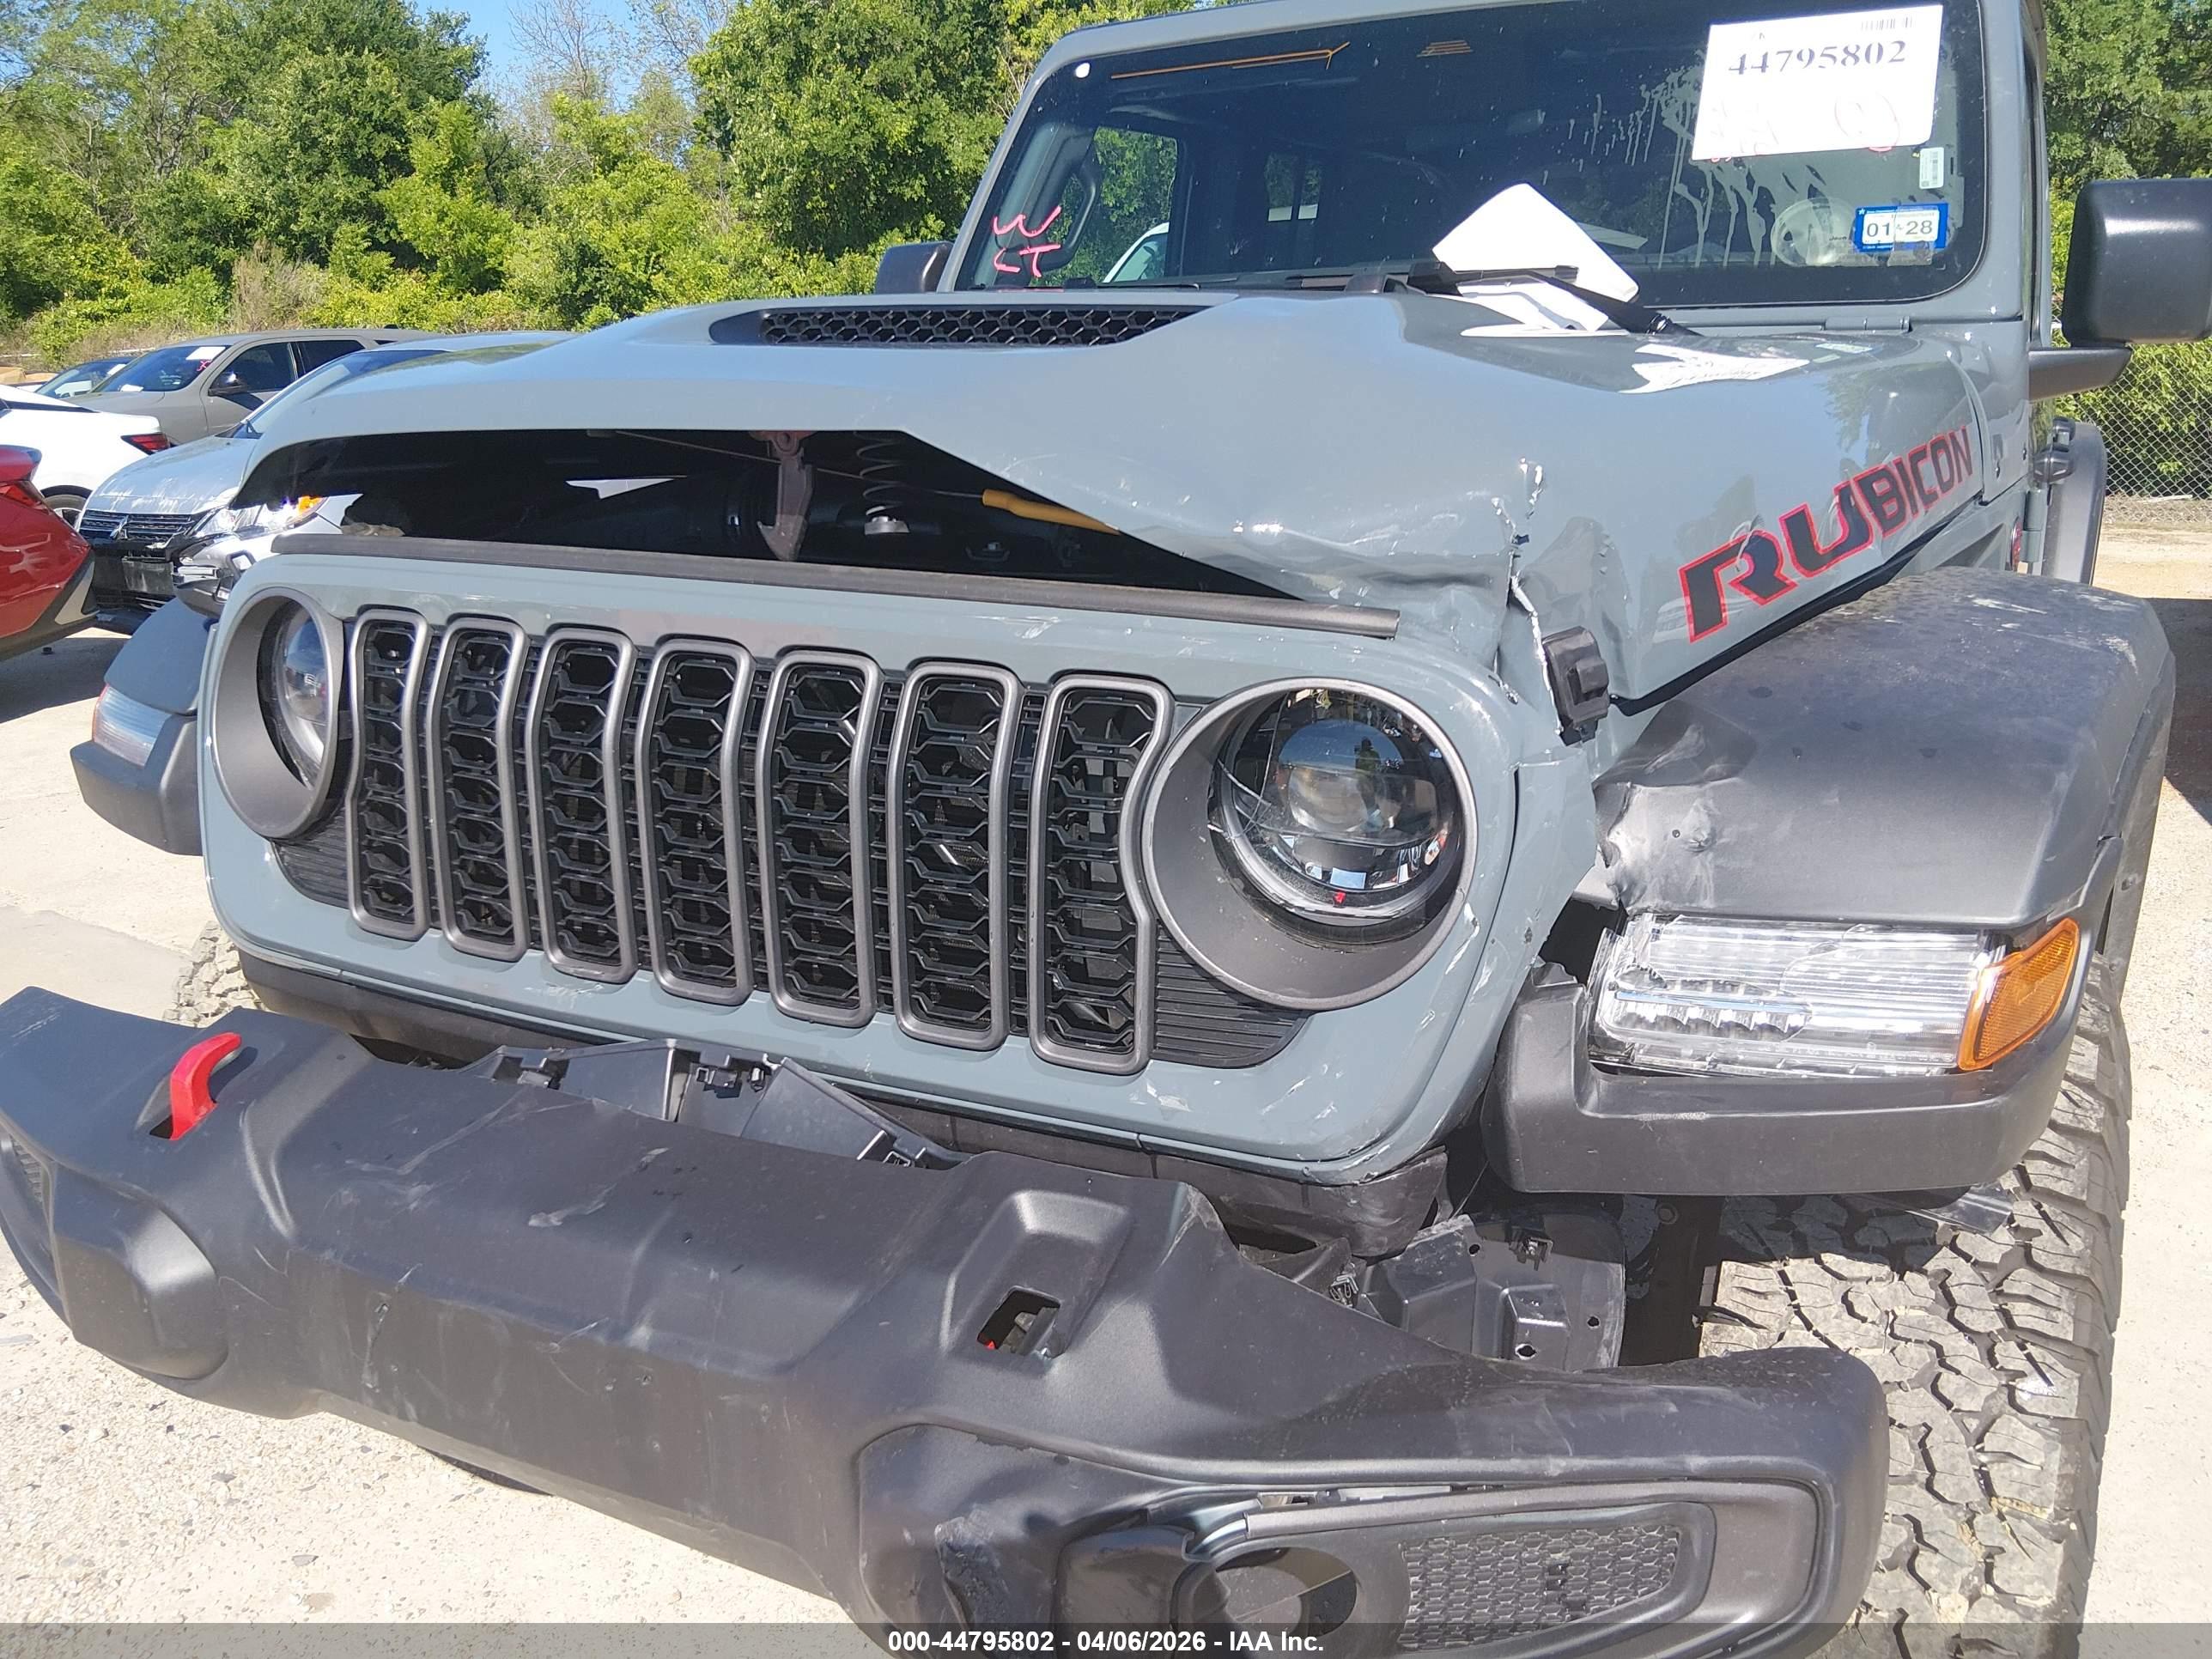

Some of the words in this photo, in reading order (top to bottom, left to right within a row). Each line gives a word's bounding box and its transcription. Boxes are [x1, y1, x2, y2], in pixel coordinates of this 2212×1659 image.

[1728, 40, 1906, 76] 44795802
[1867, 222, 1890, 237] 01
[1905, 220, 1933, 235] 28
[1679, 426, 1974, 643] RUBICON
